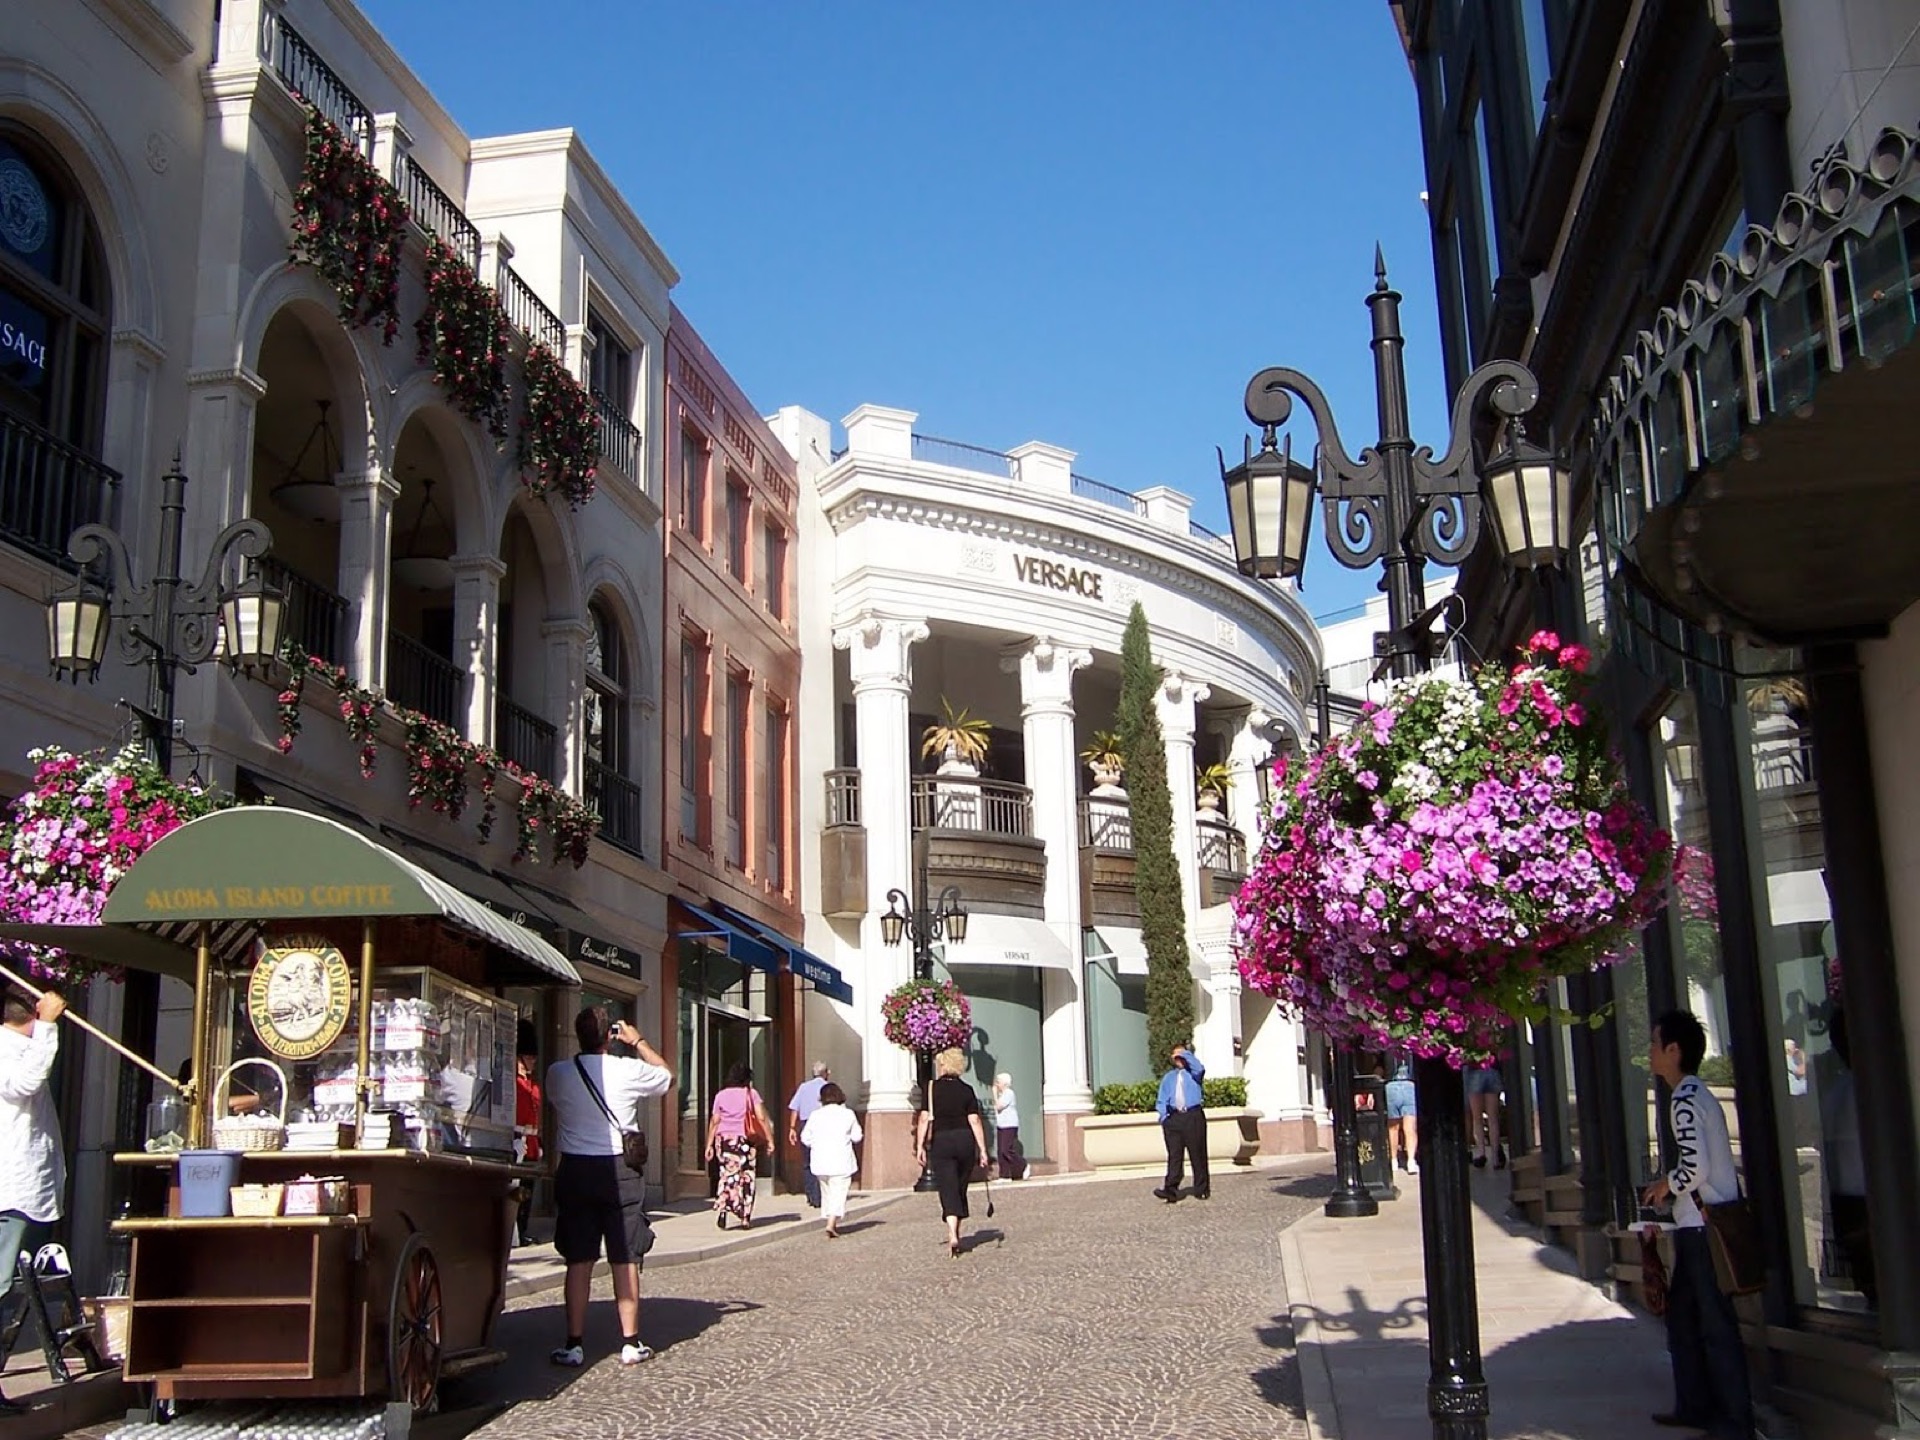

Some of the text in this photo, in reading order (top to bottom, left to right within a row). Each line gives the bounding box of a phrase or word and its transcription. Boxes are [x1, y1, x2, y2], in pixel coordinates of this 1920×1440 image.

[1013, 553, 1104, 602] VERSACE
[146, 884, 394, 911] ALOHA ISLAND COFFEE
[252, 960, 279, 1019] ALOHA
[324, 952, 347, 1016] COFFEE
